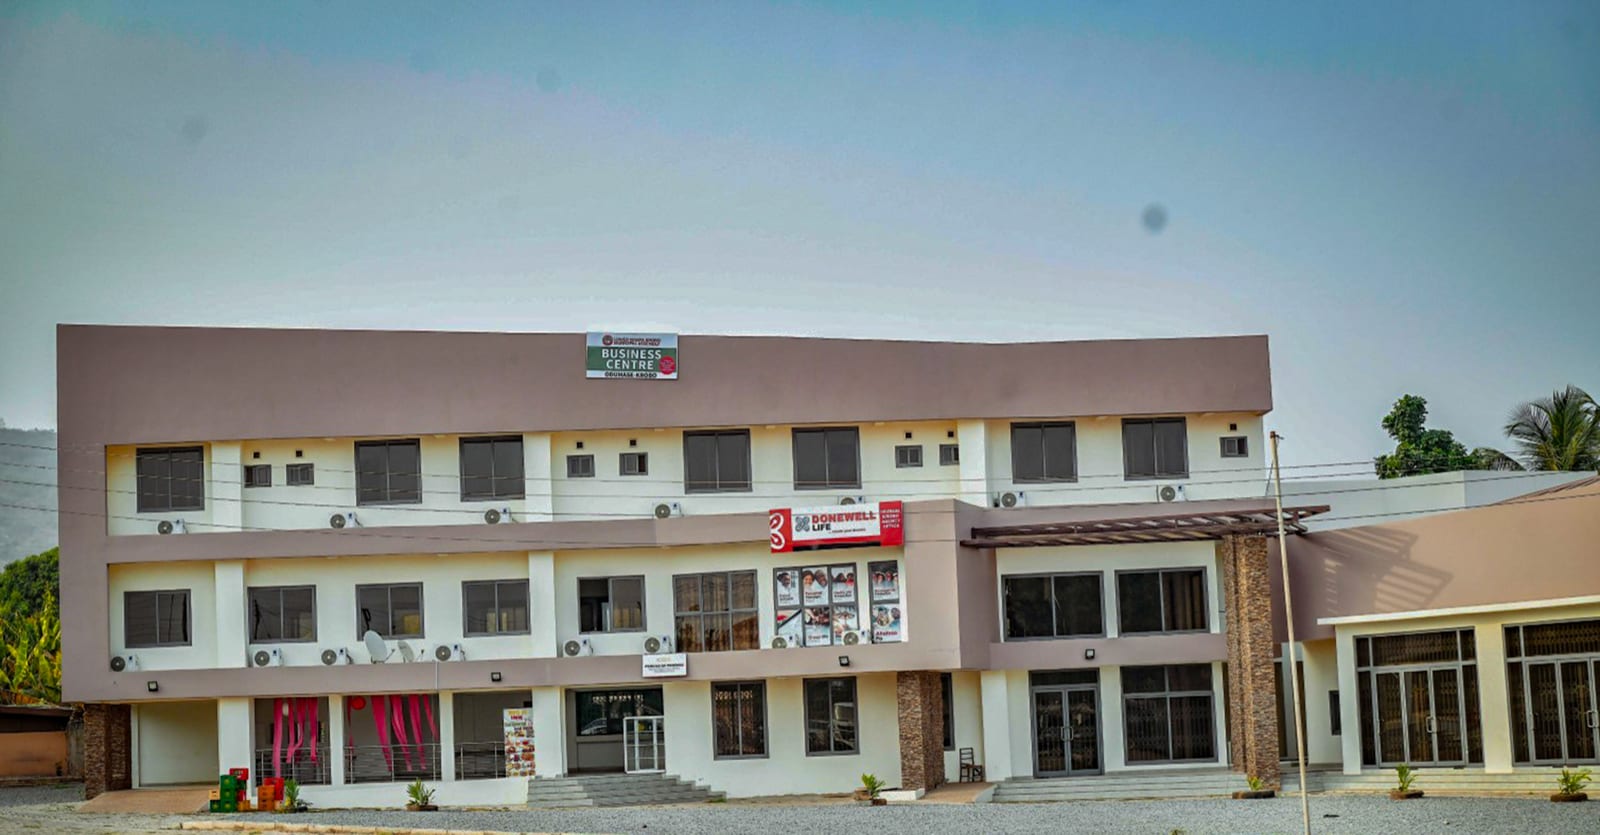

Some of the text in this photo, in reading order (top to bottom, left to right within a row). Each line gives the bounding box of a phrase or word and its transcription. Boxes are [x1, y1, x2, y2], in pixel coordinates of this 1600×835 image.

[602, 348, 662, 360] BUSINESS
[606, 359, 654, 370] CENTRE
[812, 510, 877, 524] DONEWELL
[812, 523, 832, 532] LIFE
